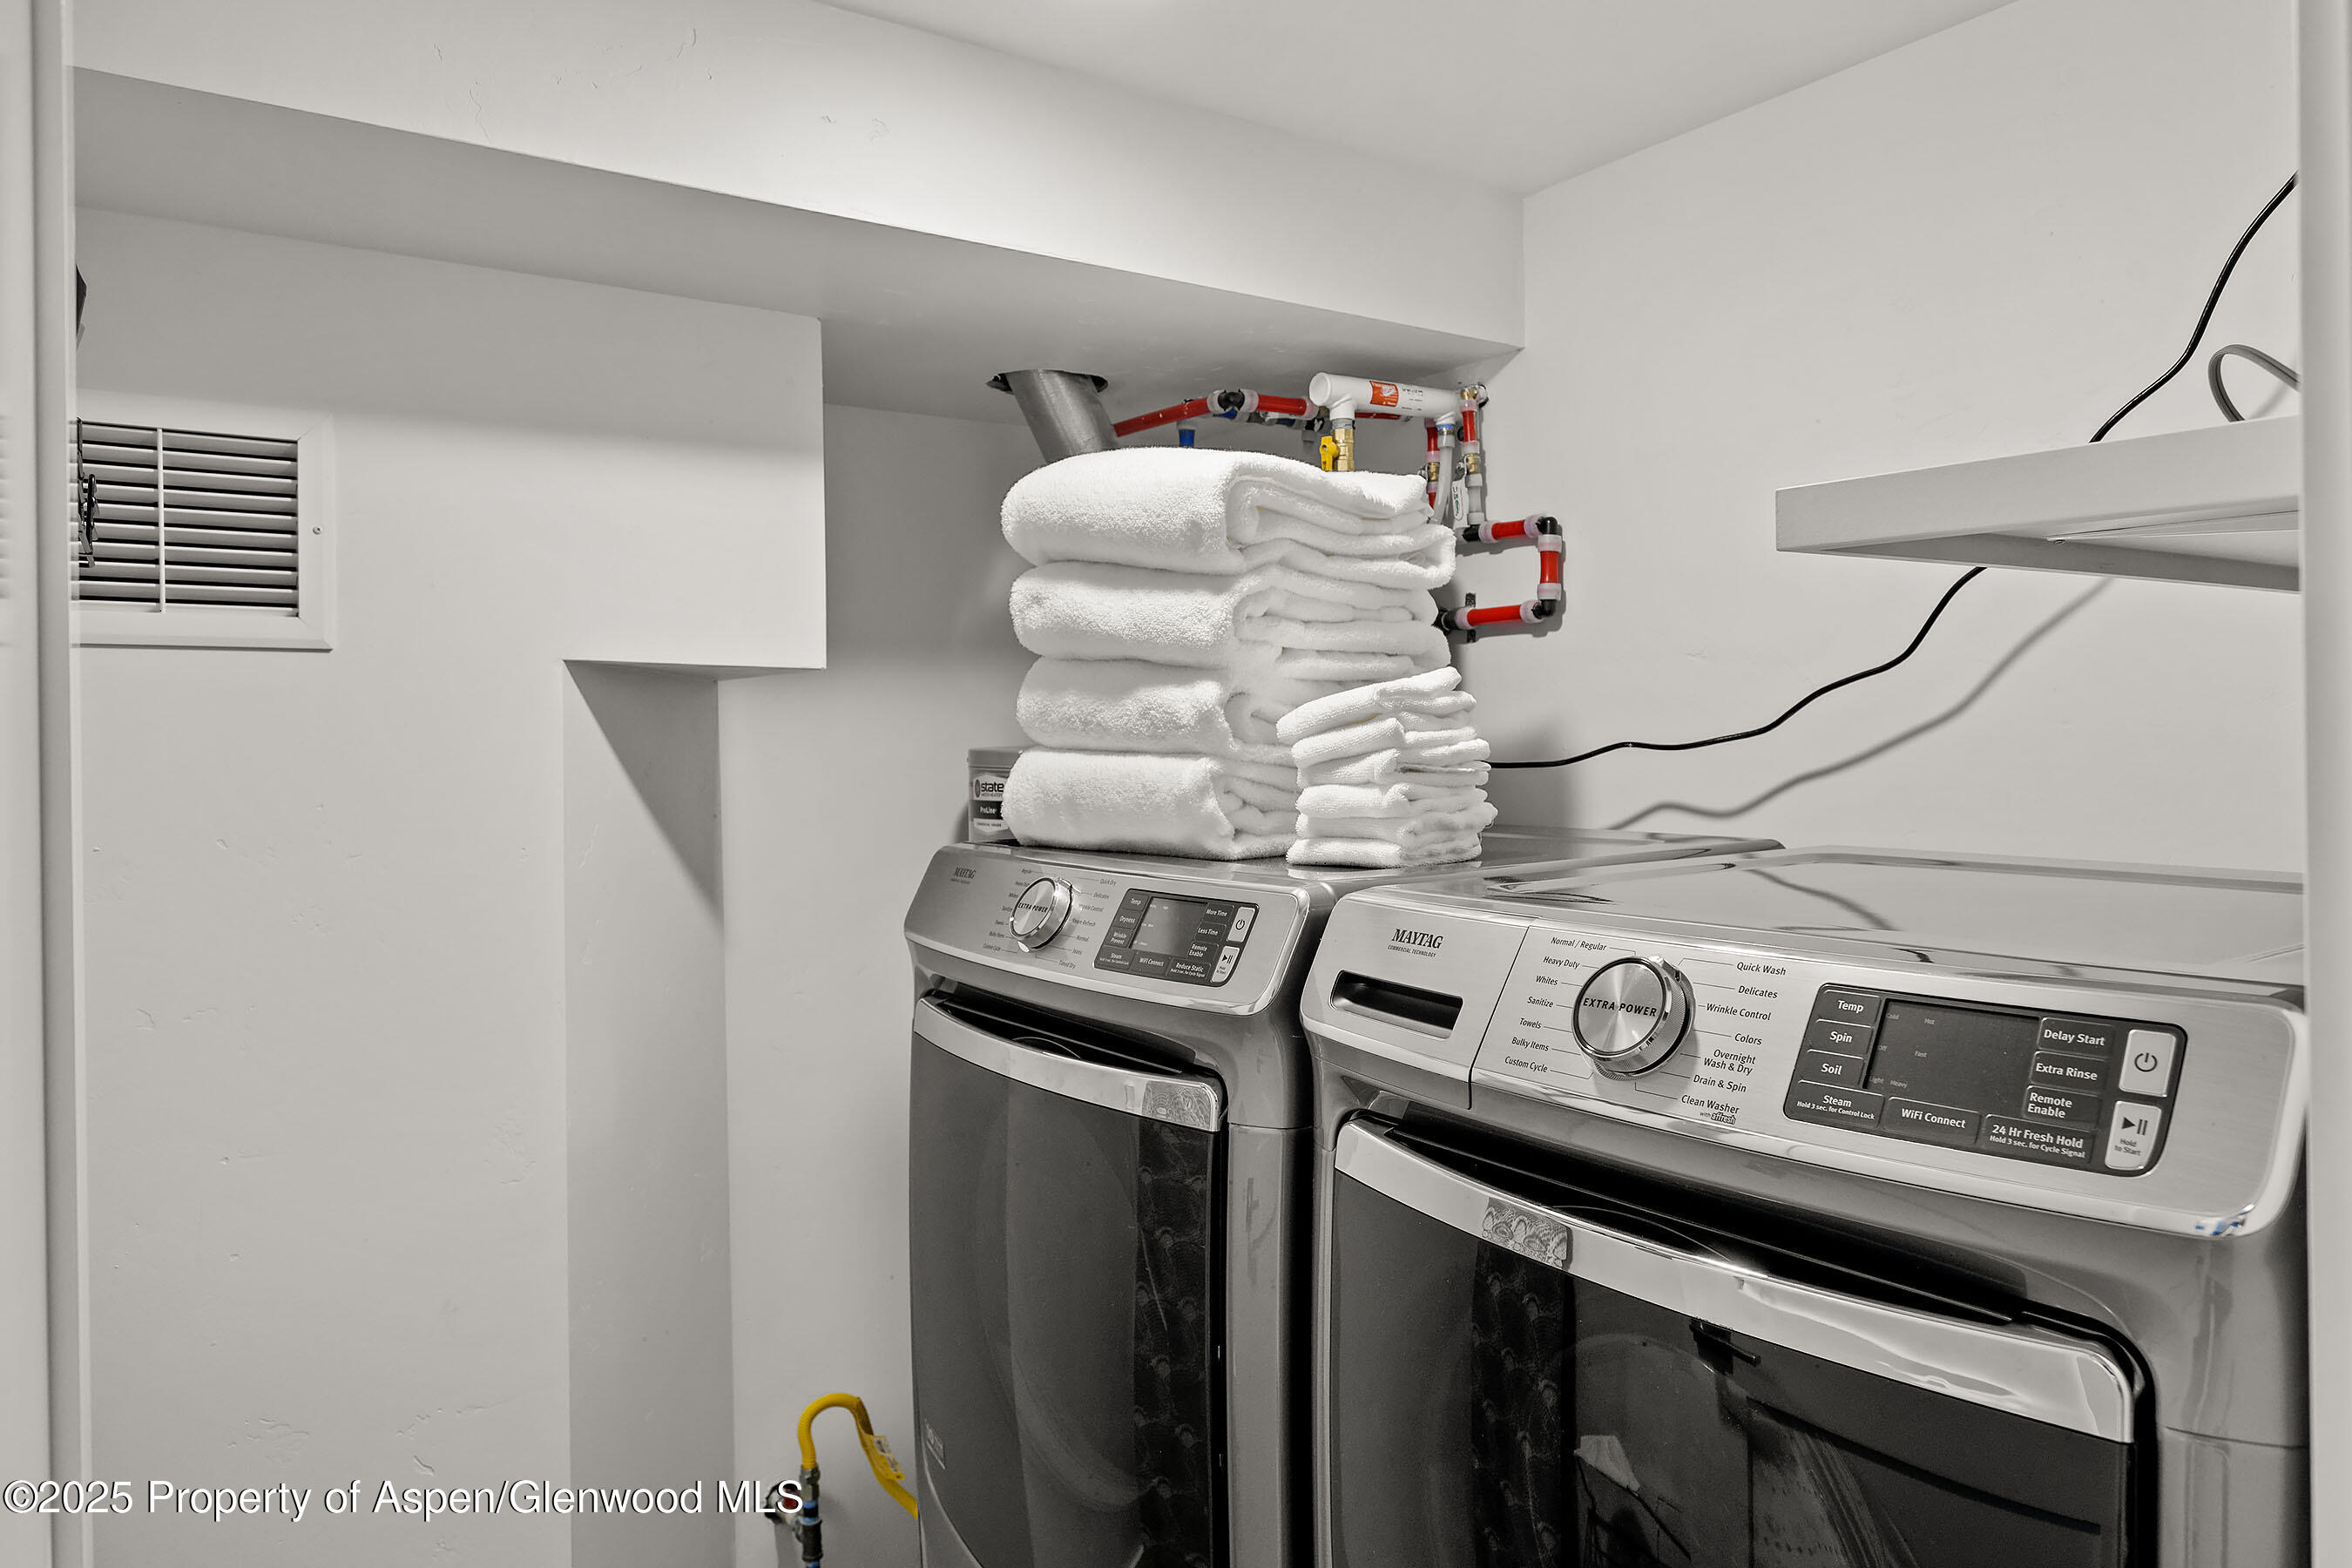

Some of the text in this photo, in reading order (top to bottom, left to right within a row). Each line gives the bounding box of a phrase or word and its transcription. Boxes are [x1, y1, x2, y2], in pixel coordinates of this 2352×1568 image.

[981, 781, 1004, 793] state
[955, 867, 976, 879] MAYTAG
[1392, 929, 1443, 949] MAYTAG
[1551, 937, 1575, 948] Normal
[1580, 941, 1607, 951] Regular
[1387, 944, 1436, 958] COMMERCIAL TECHNOLOGY
[1543, 956, 1580, 970] Heavy Duty
[1737, 961, 1786, 976] Quick Wash
[1536, 975, 1558, 985] Whites
[1738, 986, 1778, 999] Delicates
[1527, 996, 1554, 1008] Sanitize
[1583, 998, 1657, 1017] EXTRA POWER
[1838, 1000, 1864, 1013] Temp
[1706, 1003, 1771, 1021] Wrinkle Control
[1520, 1018, 1542, 1029] Towels
[1512, 1037, 1549, 1051] Bulky Items
[1735, 1033, 1762, 1046] Colors
[1830, 1031, 1853, 1043] Spin
[2044, 1029, 2105, 1046] Delay Start
[1714, 1049, 1756, 1065] Overnight
[1505, 1056, 1548, 1073] Custom Cycle
[1703, 1058, 1753, 1076] Wash & Dry
[1821, 1063, 1842, 1075] Soil
[2036, 1063, 2098, 1081] Extra Rinse
[1694, 1074, 1746, 1093] Drain & Spin
[1890, 1080, 1908, 1089] Heavy
[1681, 1095, 1740, 1113] Clean Washer
[1823, 1095, 1852, 1107] Steam
[2030, 1092, 2073, 1108] Remote
[1838, 1108, 1860, 1117] Control
[1902, 1108, 1966, 1129] WiFi Connect
[2027, 1104, 2066, 1119] Enable
[1992, 1124, 2083, 1148] 24 Hr Fresh Hold
[2120, 1139, 2137, 1147] Hold
[1989, 1135, 2006, 1144] Hold
[2040, 1144, 2060, 1153] Cycle
[2061, 1148, 2086, 1158] Signal
[2123, 1147, 2141, 1156] Start
